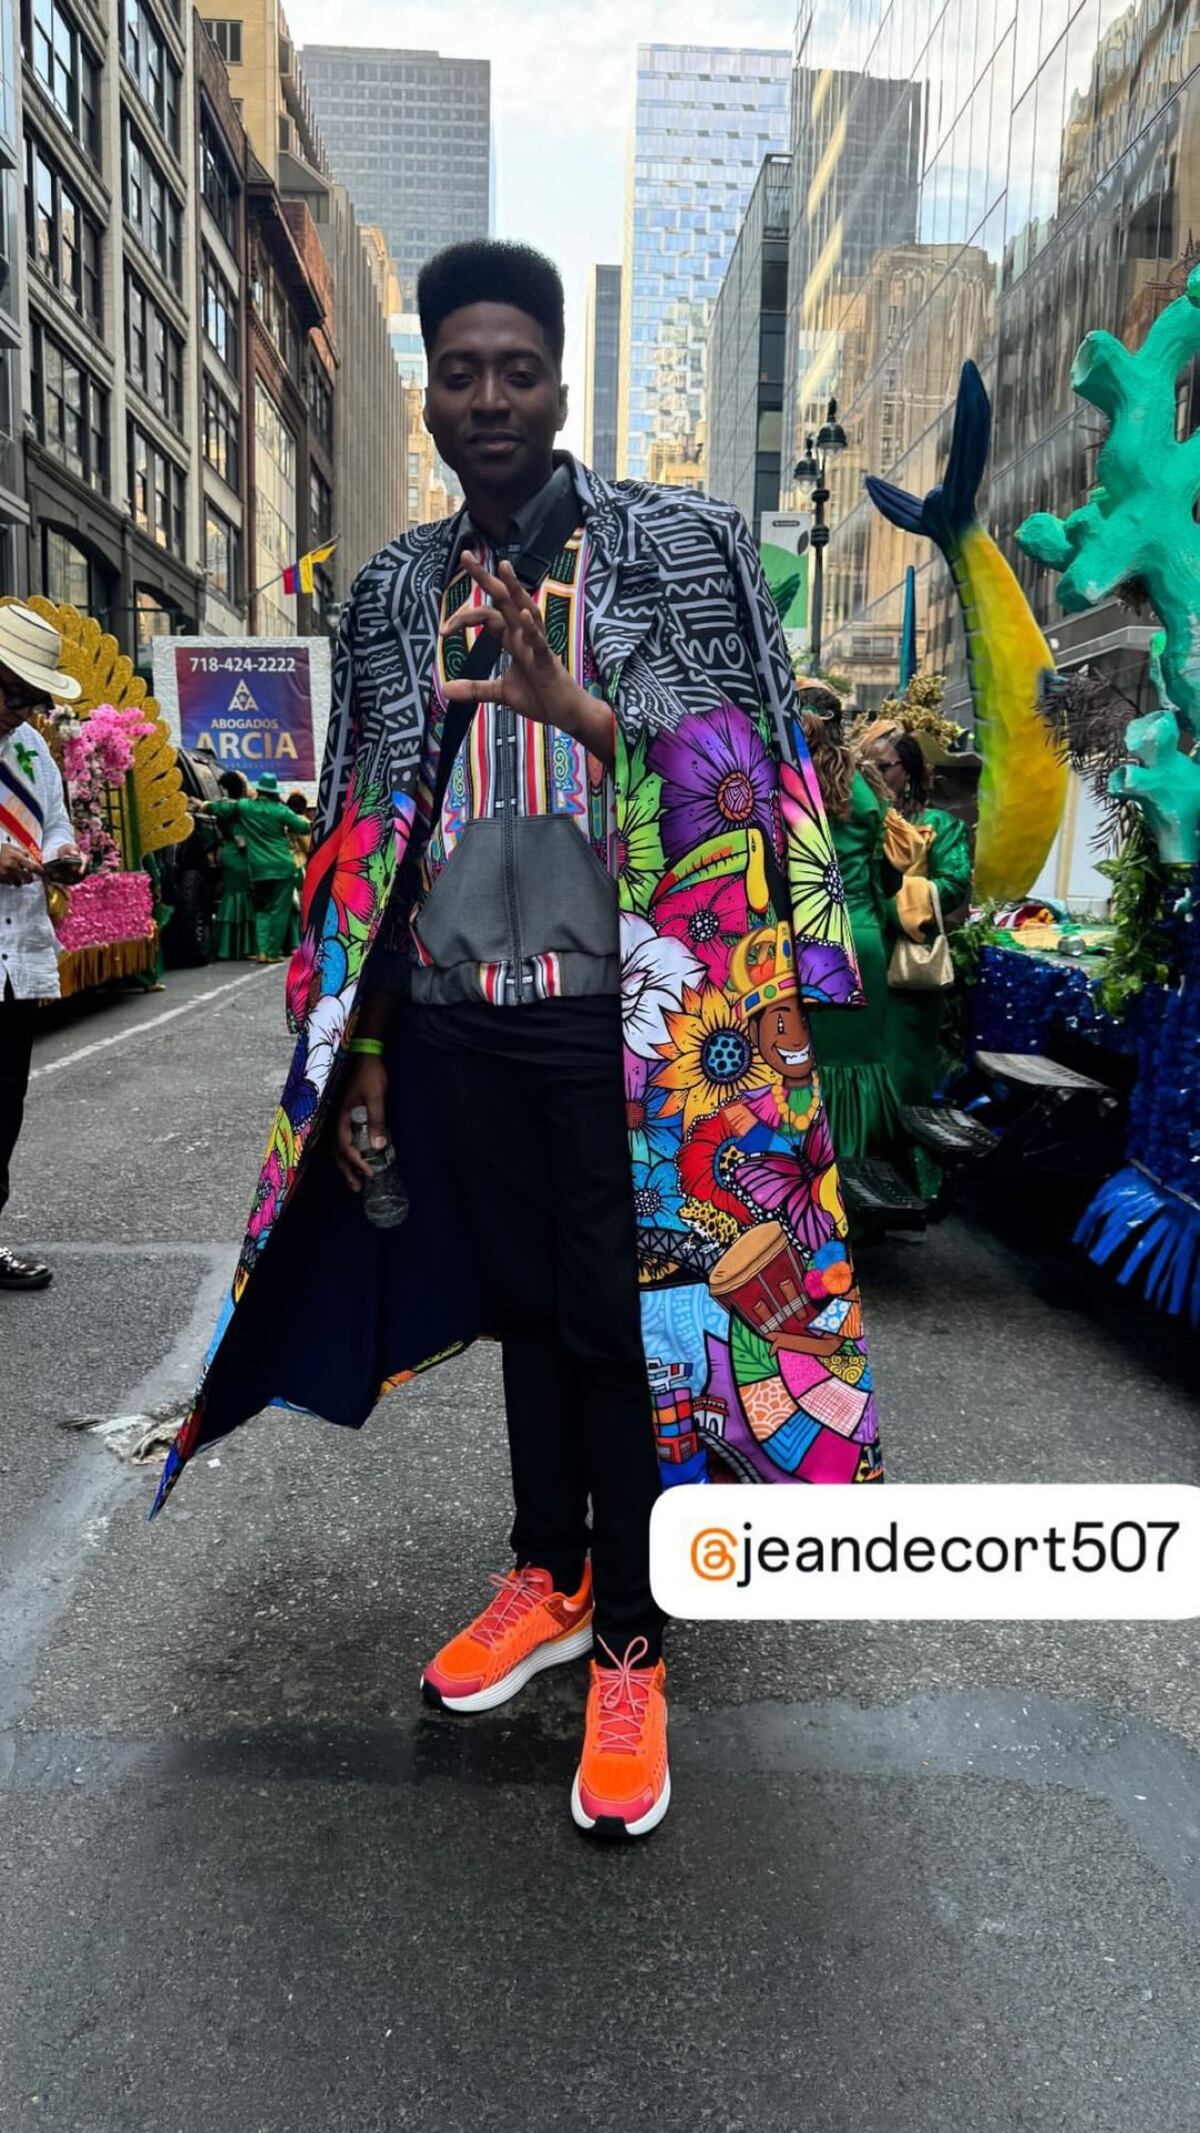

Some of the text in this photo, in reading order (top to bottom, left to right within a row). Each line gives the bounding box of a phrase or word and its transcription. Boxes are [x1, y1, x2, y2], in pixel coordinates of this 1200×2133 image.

[190, 657, 296, 673] 718-424-2222
[211, 718, 279, 730] ABOGADOS
[197, 731, 299, 760] ARCIA
